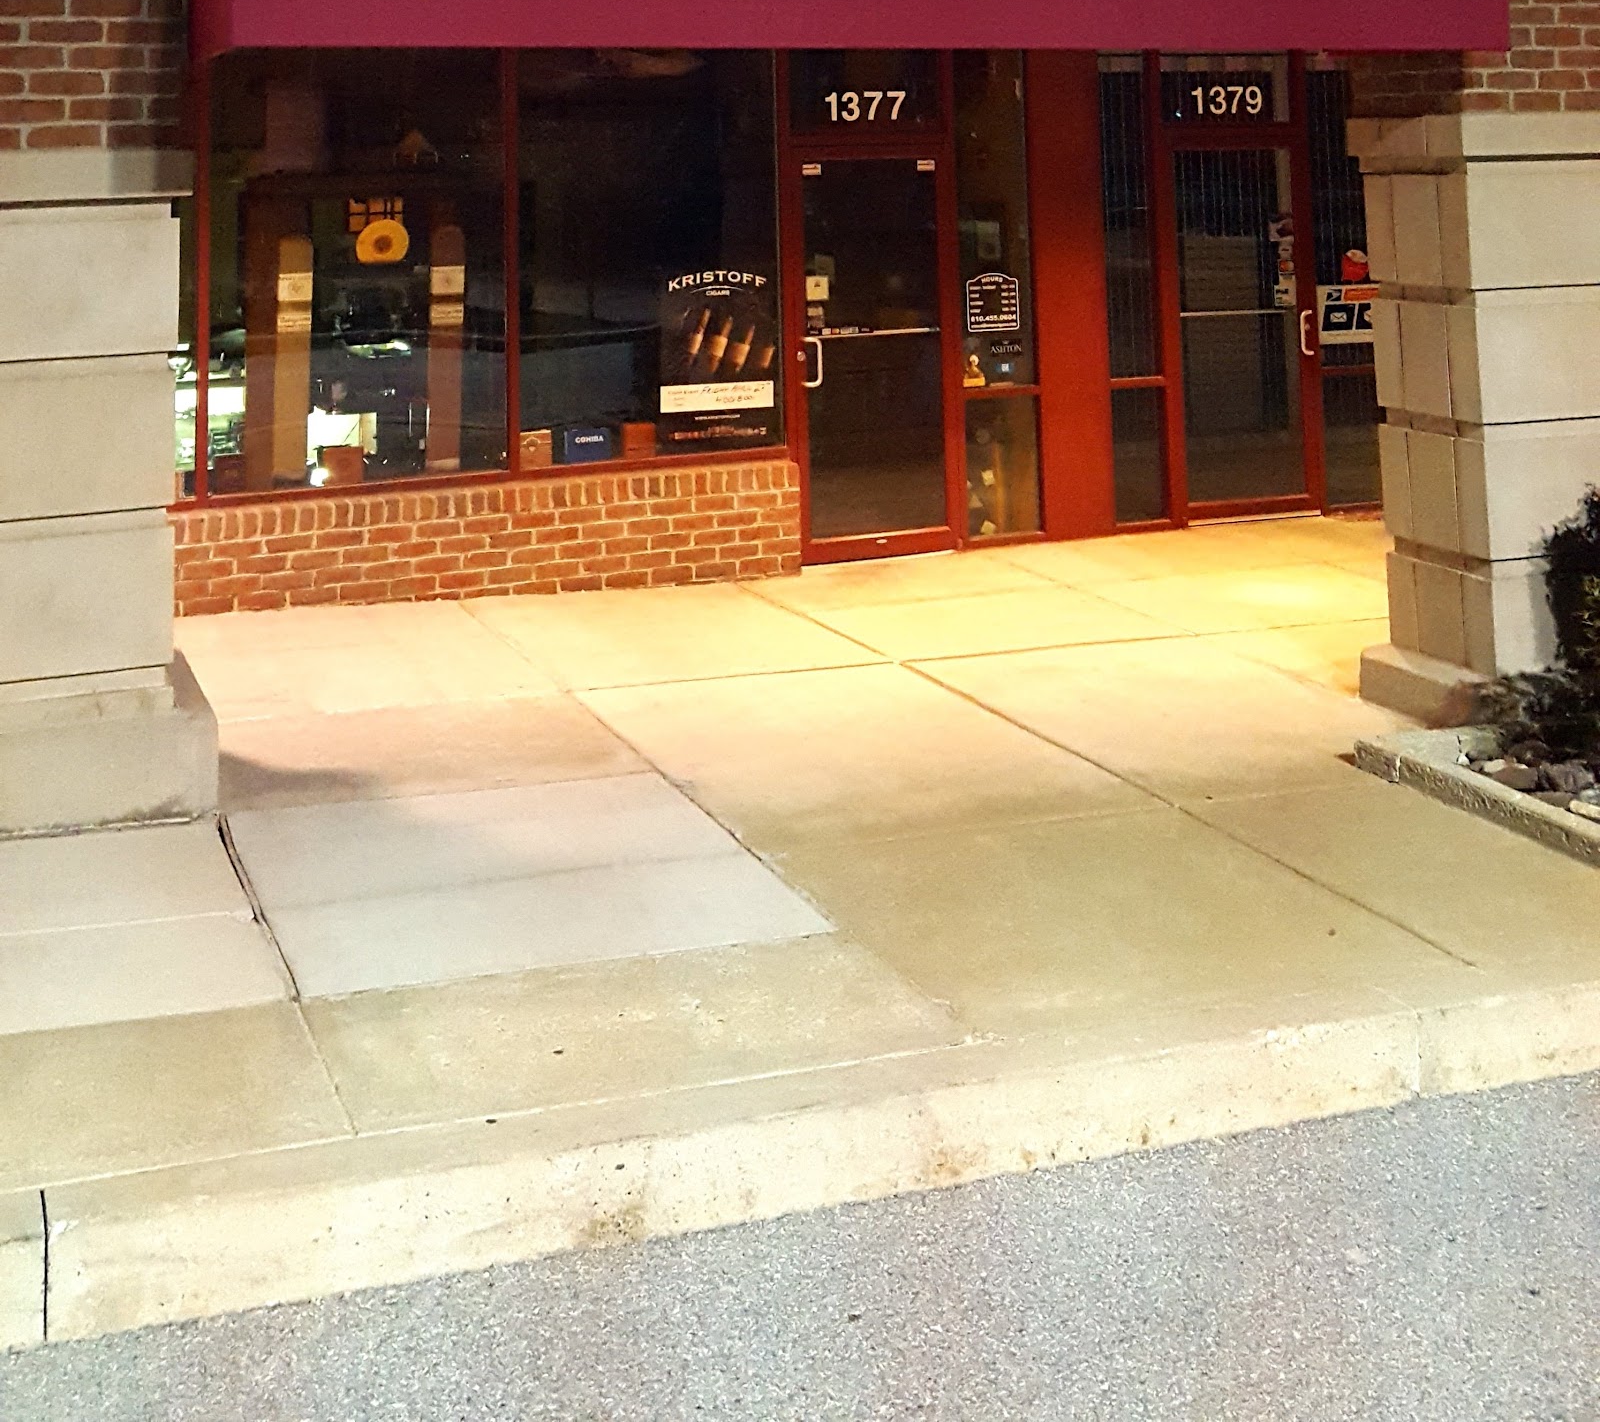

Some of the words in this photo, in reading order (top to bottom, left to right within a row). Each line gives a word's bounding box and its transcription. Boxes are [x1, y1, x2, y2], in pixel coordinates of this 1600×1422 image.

[824, 90, 907, 122] 1377
[1191, 85, 1263, 115] 1379
[668, 270, 767, 292] KRISTOFF
[990, 344, 1021, 353] ASHTON
[574, 434, 605, 444] COHIBA
